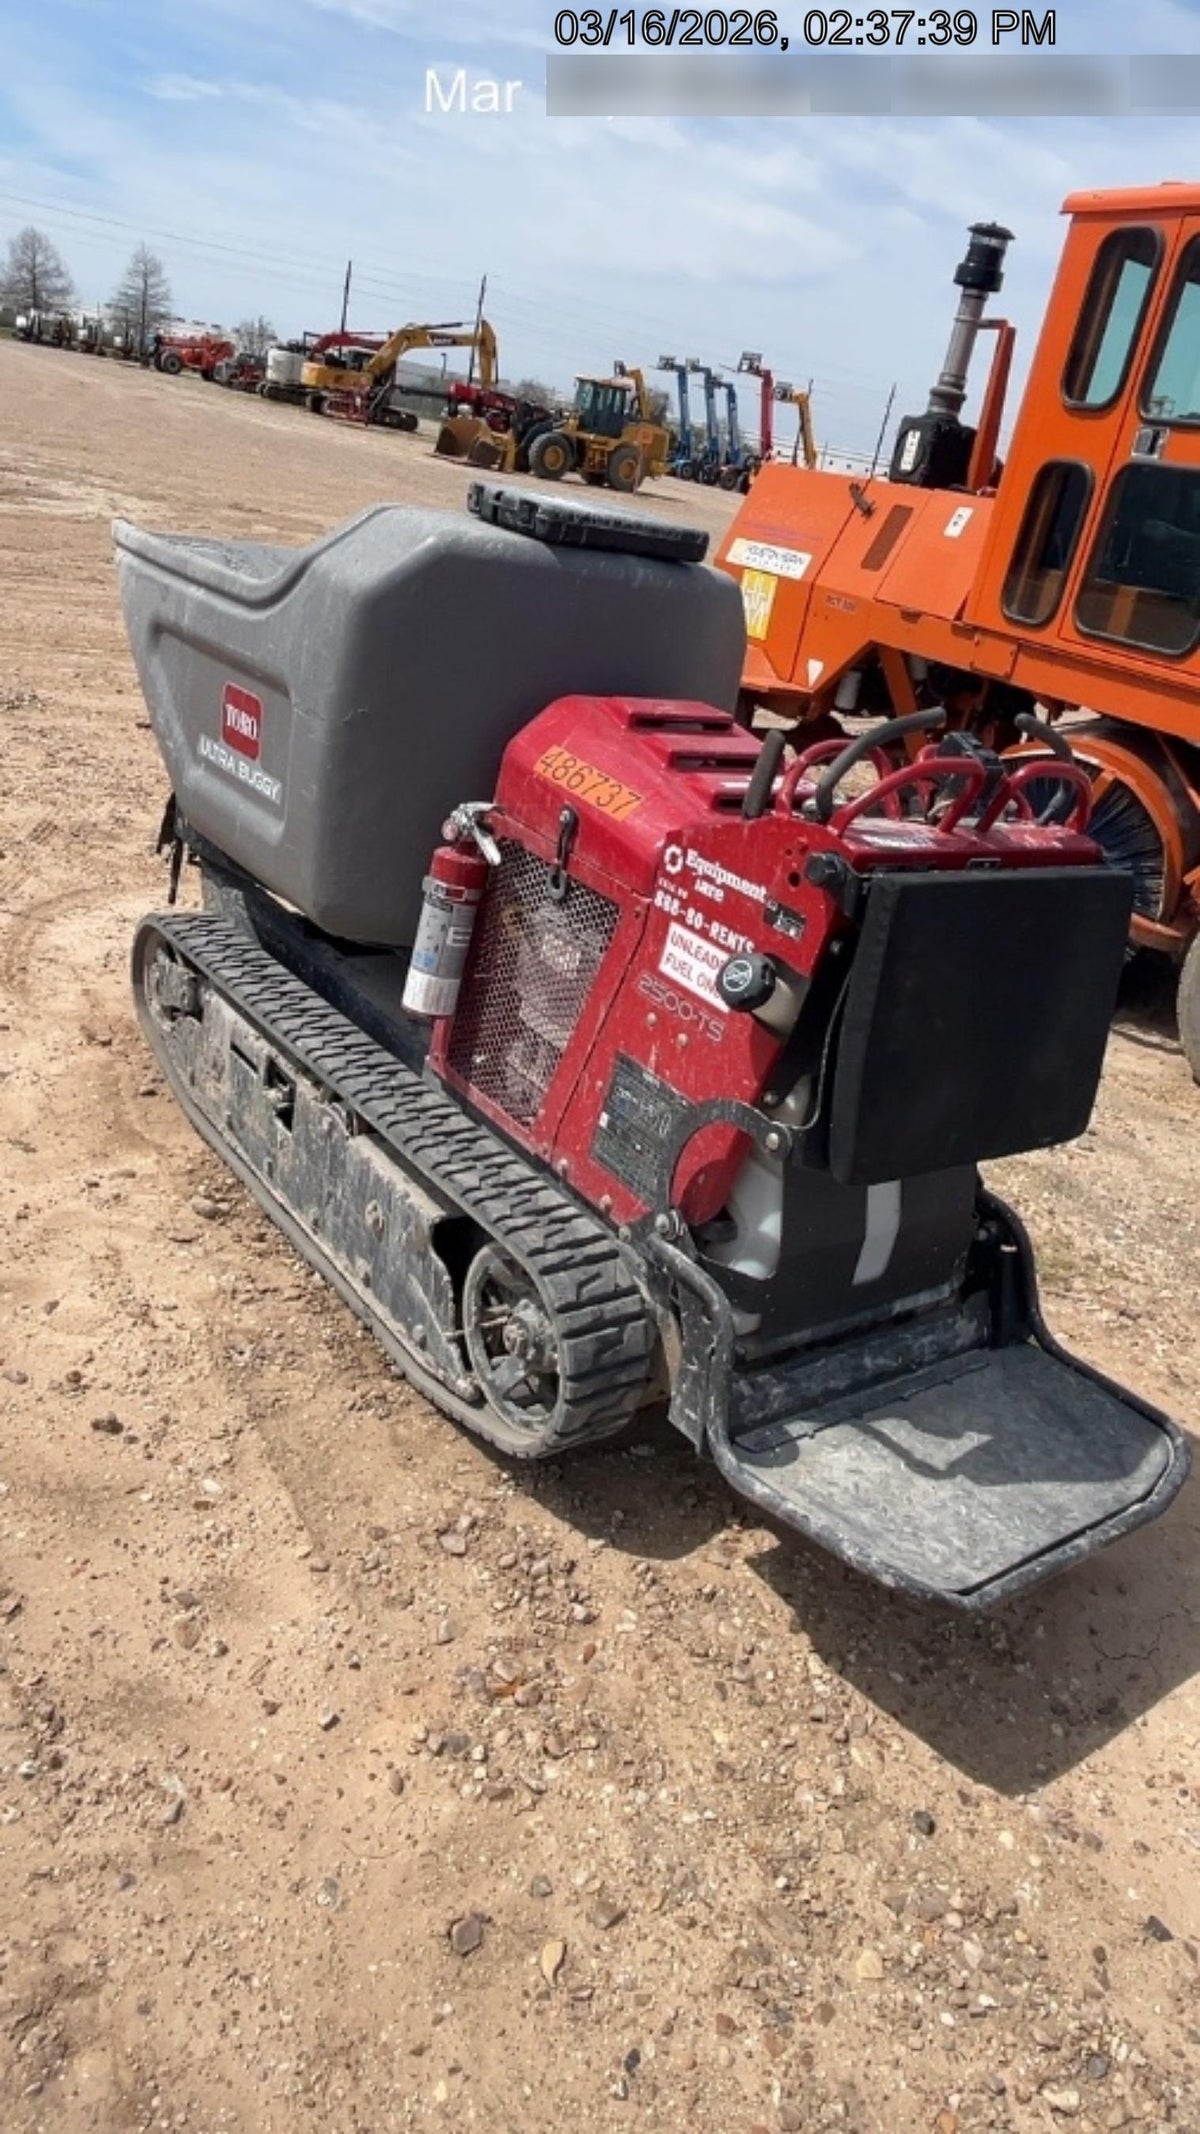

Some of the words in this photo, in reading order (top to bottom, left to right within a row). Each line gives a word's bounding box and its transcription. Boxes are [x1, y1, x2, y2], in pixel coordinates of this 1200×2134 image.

[224, 703, 258, 740] TORO
[199, 735, 236, 775] ULTRA
[238, 761, 280, 804] BUGGY
[540, 751, 642, 814] 486737
[686, 848, 767, 904] Equipment
[664, 952, 694, 983] FUEL
